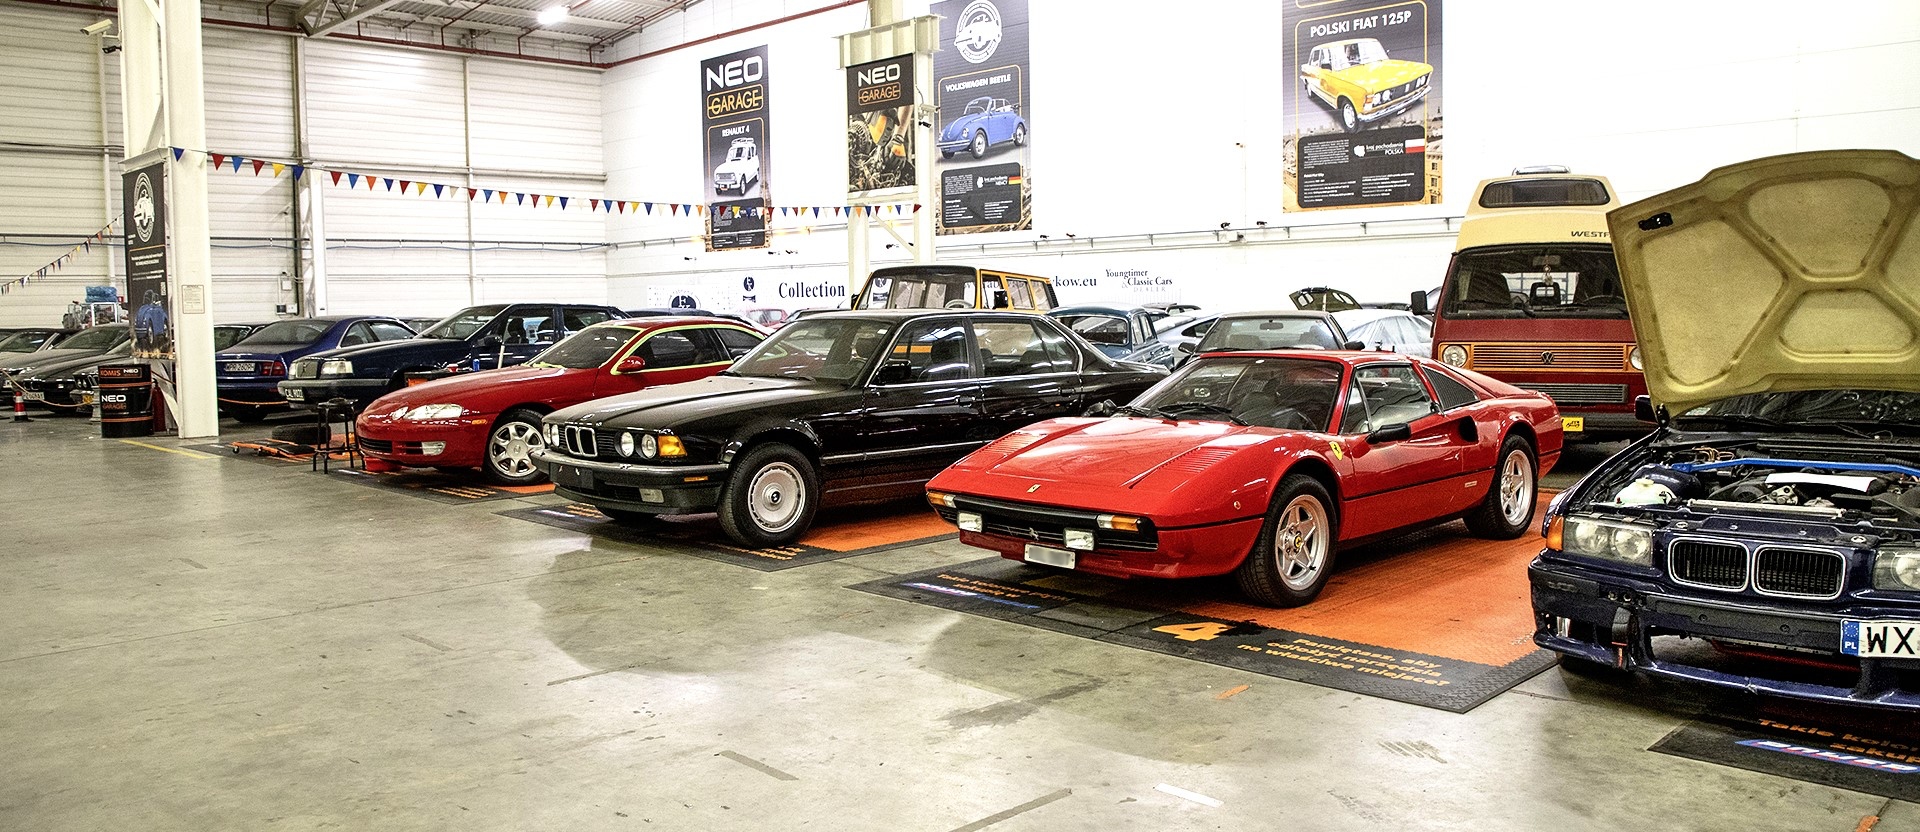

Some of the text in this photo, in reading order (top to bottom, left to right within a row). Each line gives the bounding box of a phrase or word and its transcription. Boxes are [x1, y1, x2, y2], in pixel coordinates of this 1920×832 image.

[1310, 10, 1412, 38] POLSKI FIAT 125P
[706, 55, 763, 92] NEO
[857, 63, 901, 88] NEO
[945, 73, 1012, 92] VOLKSWAGEN BEETLE
[711, 89, 759, 115] GARAGE
[861, 85, 898, 103] GARAGE
[721, 125, 750, 137] RENAULT 4
[1105, 269, 1149, 280] Youngtimer
[1127, 277, 1153, 286] Classic
[1155, 276, 1173, 286] Cars
[778, 281, 846, 298] Collection
[101, 394, 127, 403] NEO
[1152, 621, 1232, 642] 4
[1866, 625, 1916, 655] WX
[1236, 644, 1262, 652] na
[1844, 641, 1857, 650] PL
[1401, 657, 1443, 669] aby
[1758, 718, 1836, 737] Takie
